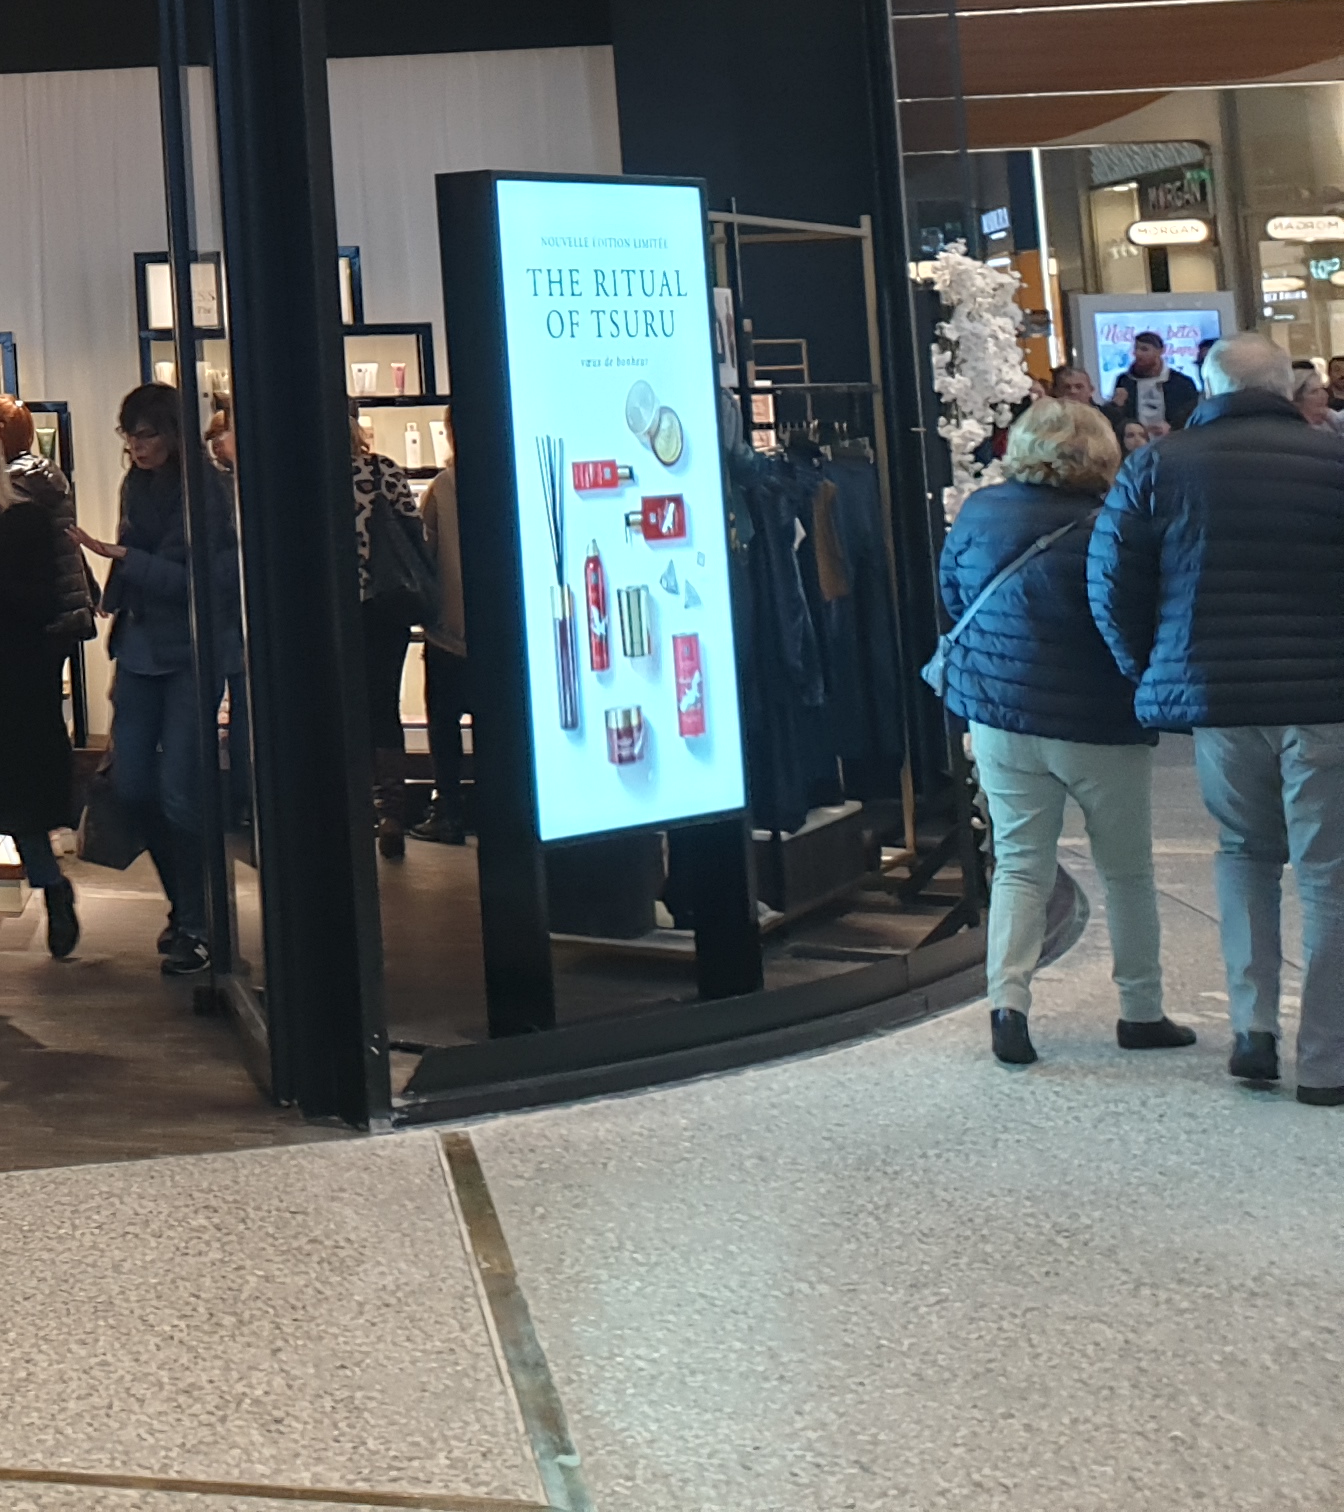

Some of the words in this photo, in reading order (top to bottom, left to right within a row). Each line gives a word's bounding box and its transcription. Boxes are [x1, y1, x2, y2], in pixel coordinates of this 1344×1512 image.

[1137, 225, 1200, 235] MORGAN
[541, 236, 589, 248] NOUVELLE
[526, 268, 582, 297] THE
[593, 269, 688, 297] RITUAL
[546, 310, 580, 339] OF
[590, 310, 675, 338] TSURU
